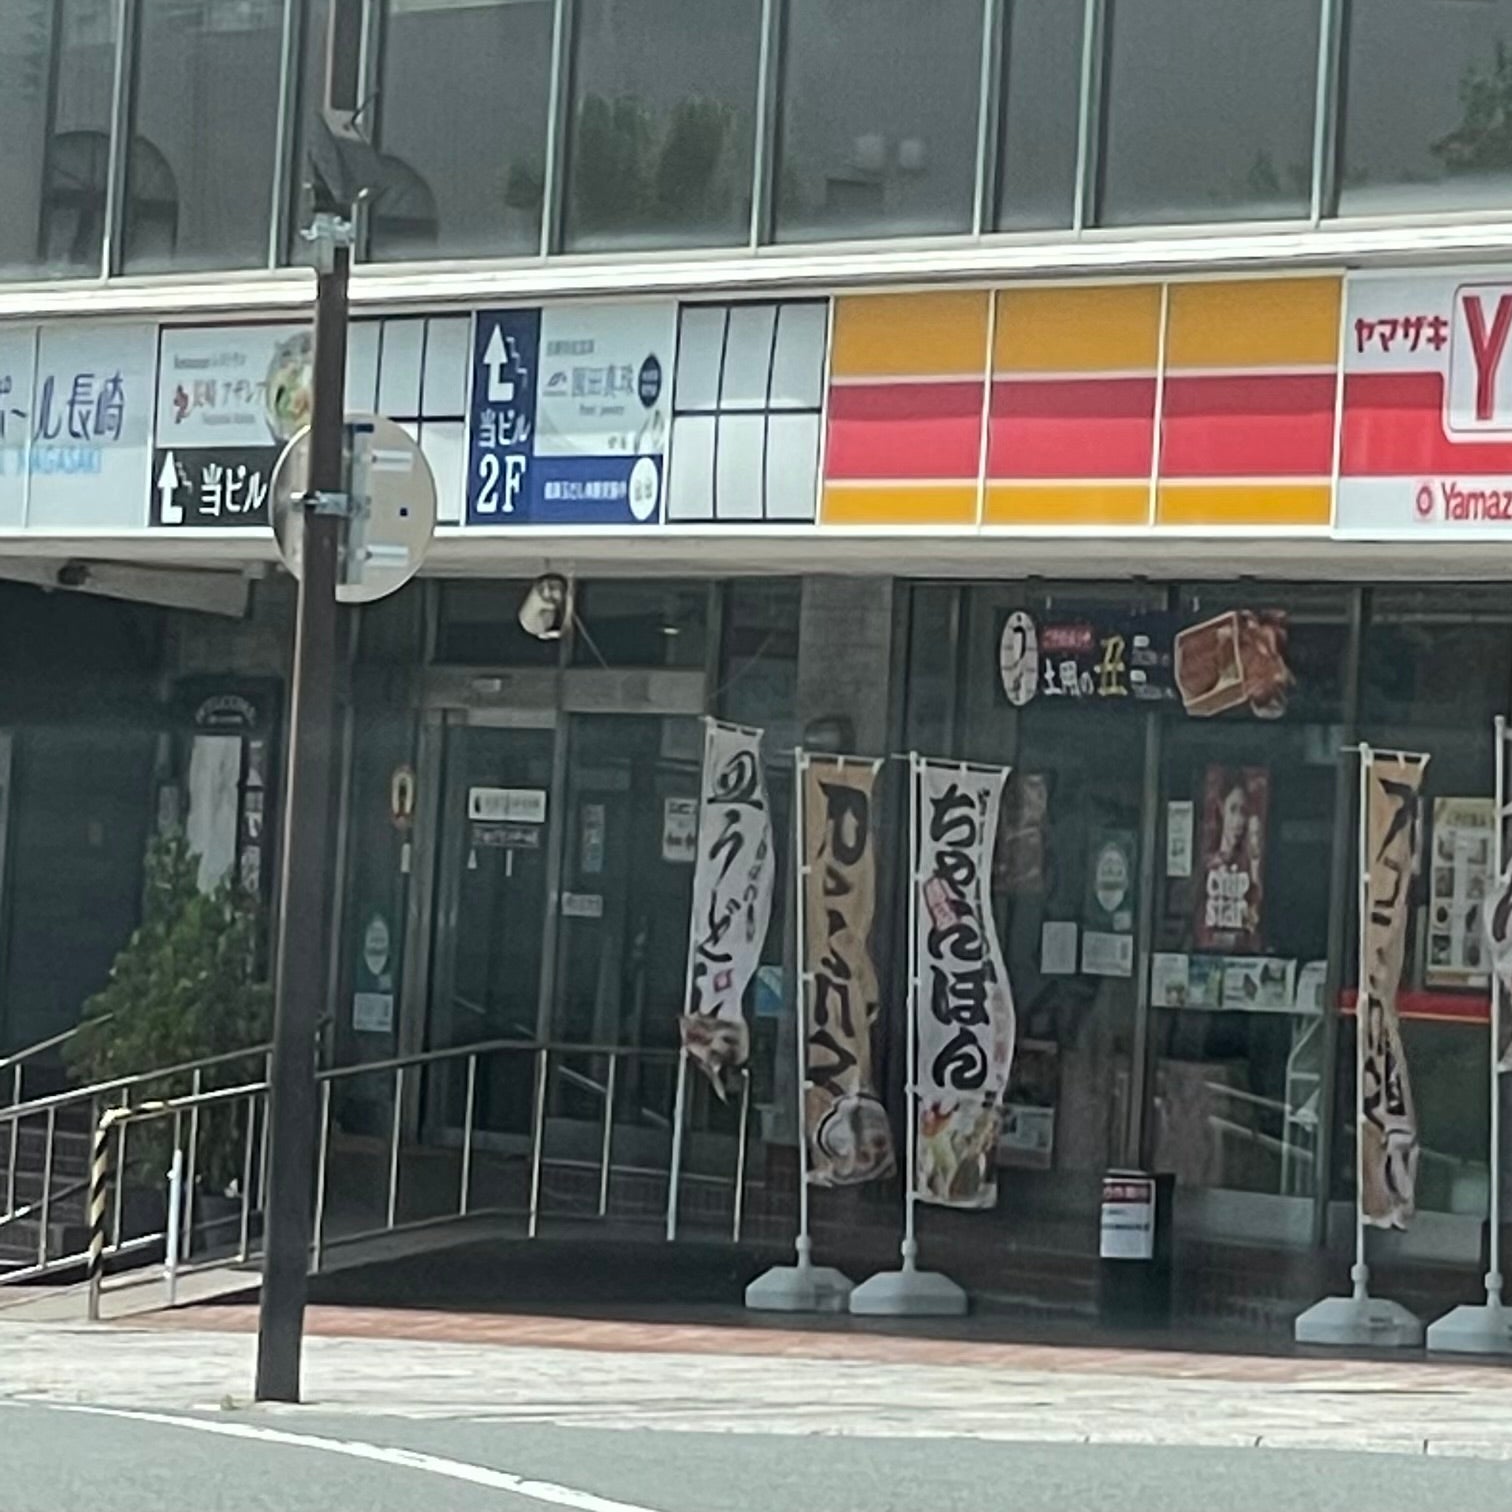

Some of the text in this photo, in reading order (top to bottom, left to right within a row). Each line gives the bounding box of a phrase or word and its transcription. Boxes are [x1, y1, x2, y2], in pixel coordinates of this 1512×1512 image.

[1354, 315, 1449, 353] ヤマザキ
[476, 453, 527, 513] 2F
